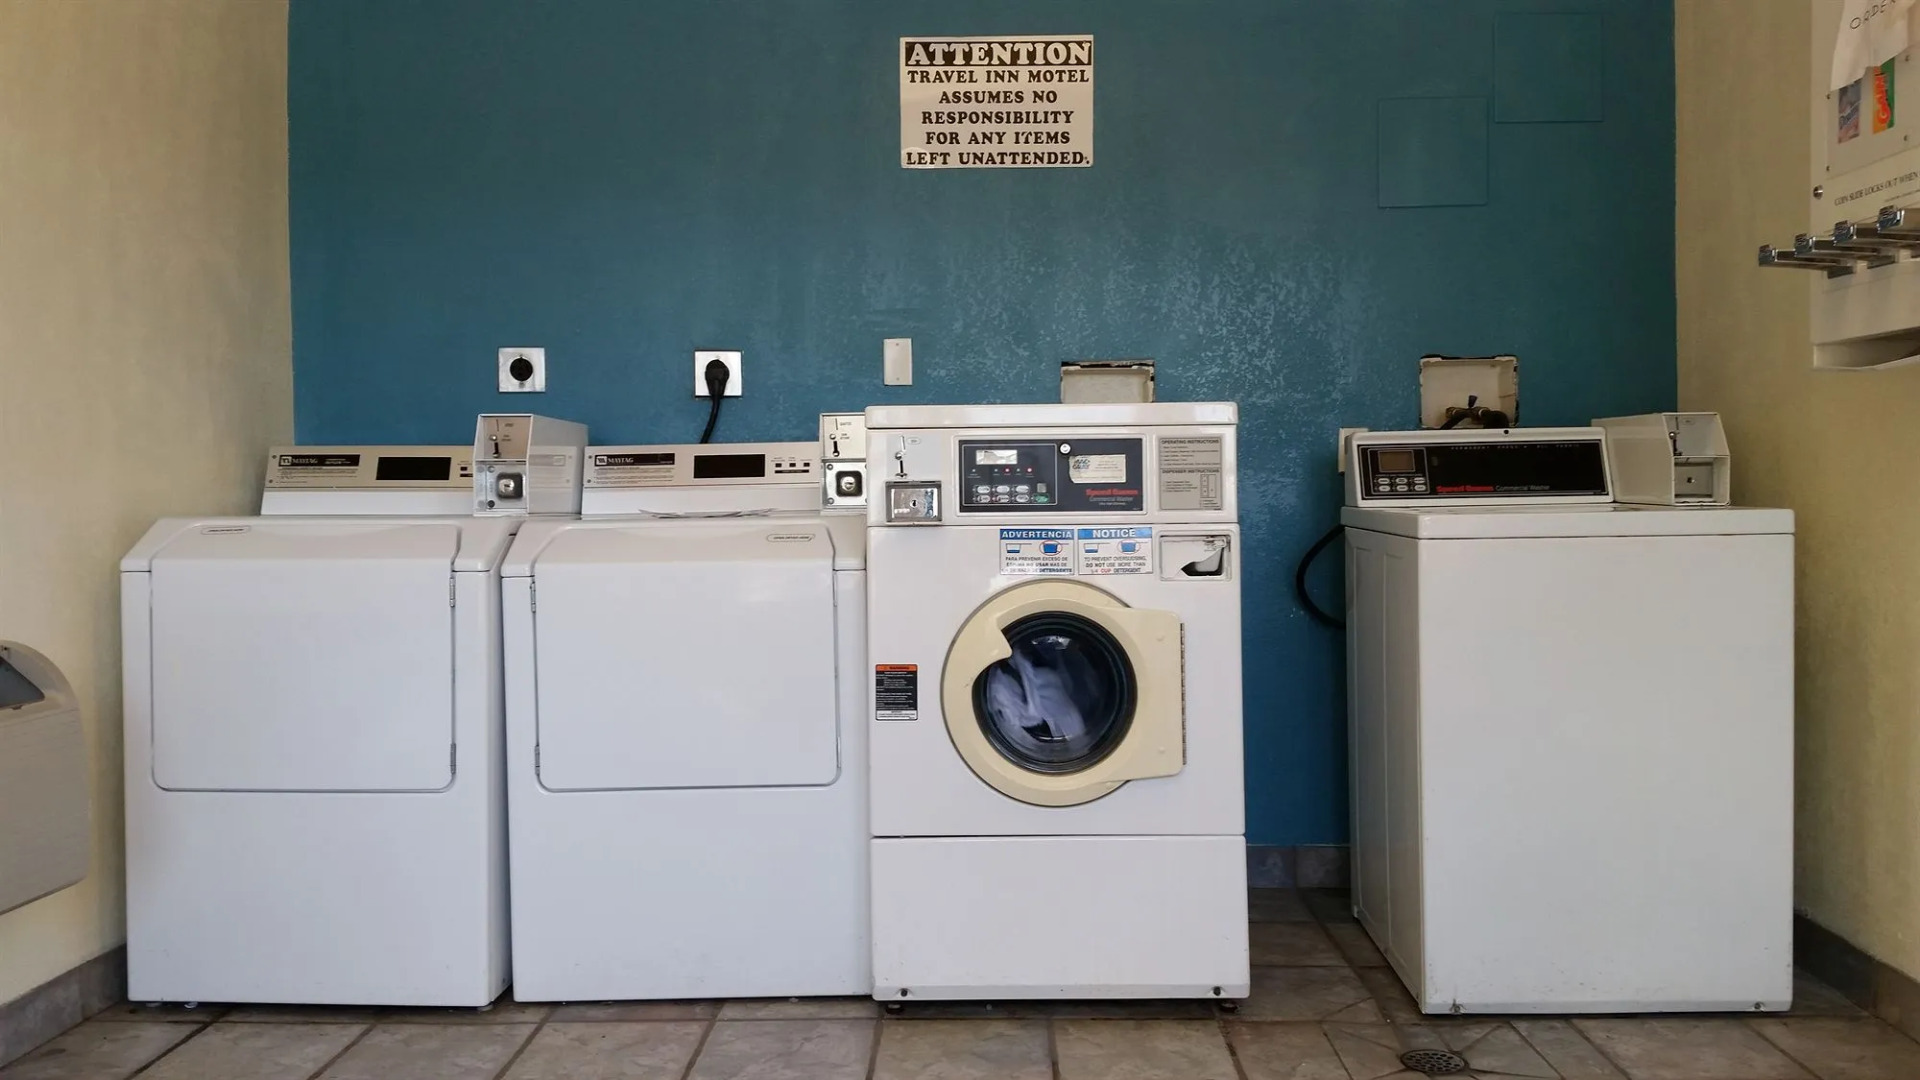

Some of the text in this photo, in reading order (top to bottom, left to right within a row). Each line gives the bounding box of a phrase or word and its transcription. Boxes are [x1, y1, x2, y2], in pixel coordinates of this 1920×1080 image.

[907, 41, 1091, 65] ATTENTION
[907, 69, 1090, 83] TRAVEL INN MOTEL
[939, 90, 1058, 104] ASSUMES NO
[921, 110, 1074, 124] RESPONSIBILITY
[925, 131, 1071, 144] FOR ANY ITEMS
[906, 151, 1090, 165] LEFT UNATTENDED.
[1864, 183, 1884, 196] LOCKS
[1898, 171, 1918, 184] WHEN
[1002, 530, 1072, 538] ADVERTENCIA
[1093, 529, 1136, 538] NOTICE
